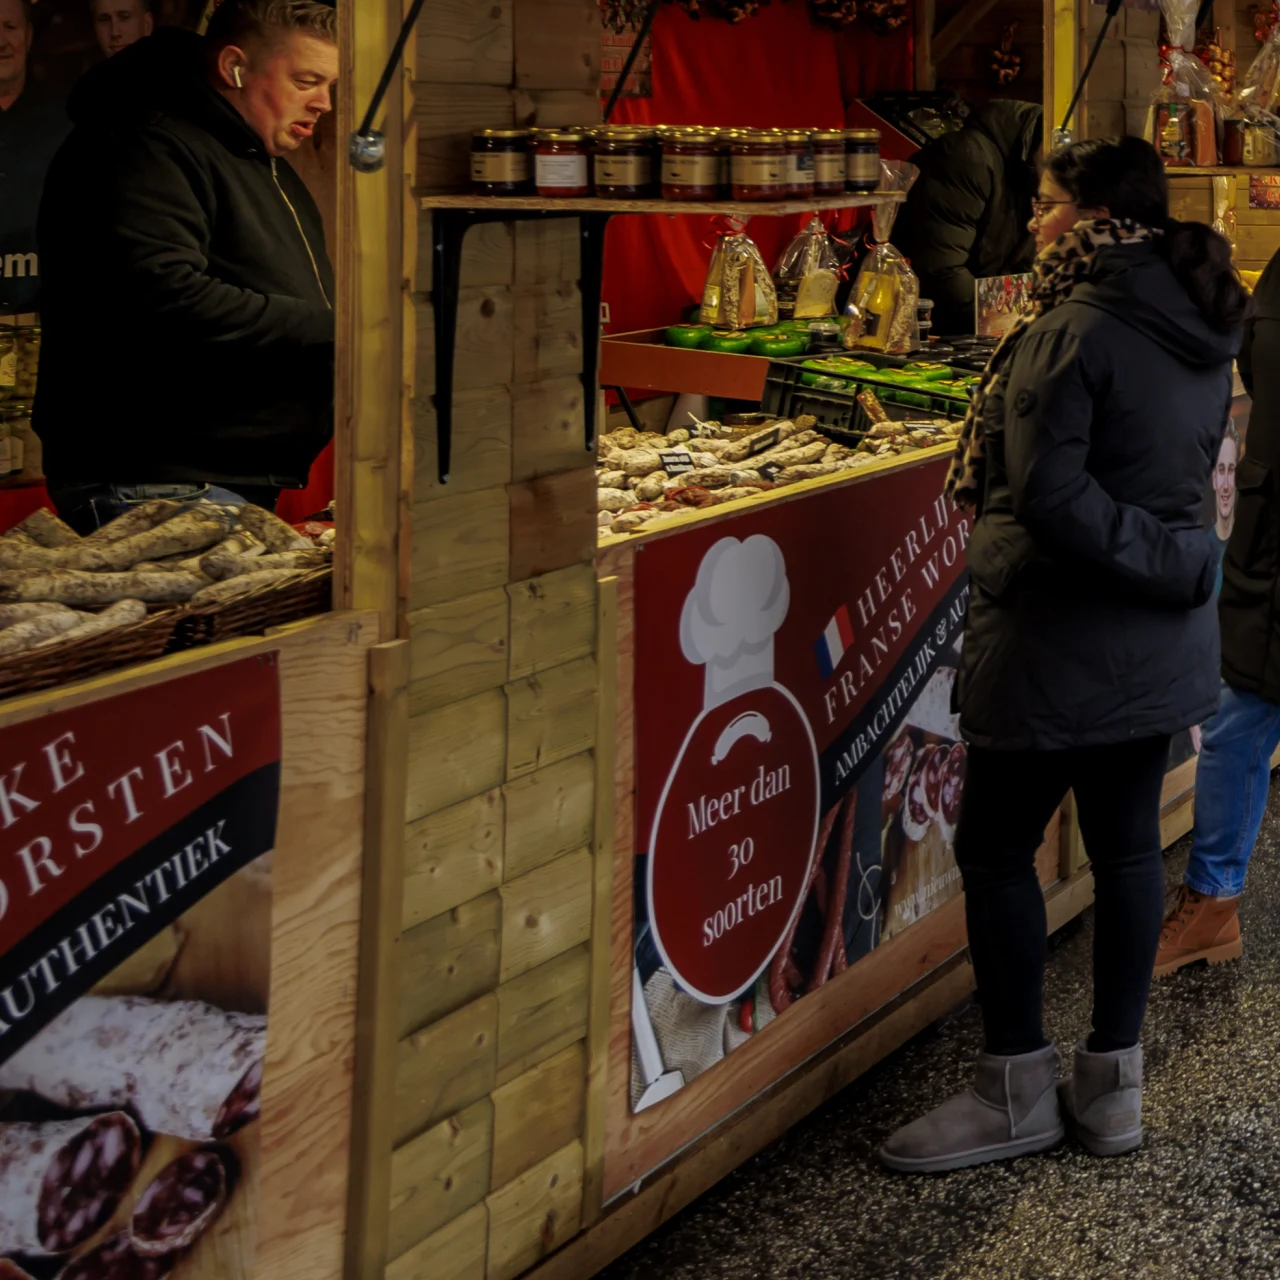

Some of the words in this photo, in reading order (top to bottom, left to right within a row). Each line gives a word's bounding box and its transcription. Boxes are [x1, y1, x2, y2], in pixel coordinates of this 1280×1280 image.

[823, 588, 917, 724] FRANSE
[921, 516, 975, 590] WOR
[834, 639, 937, 785] AMBACHTELIJK
[935, 617, 947, 646] &
[0, 712, 234, 921] RSTEN
[687, 783, 746, 840] Meer
[750, 763, 791, 806] dan
[728, 836, 754, 881] 30
[703, 874, 783, 948] soorten
